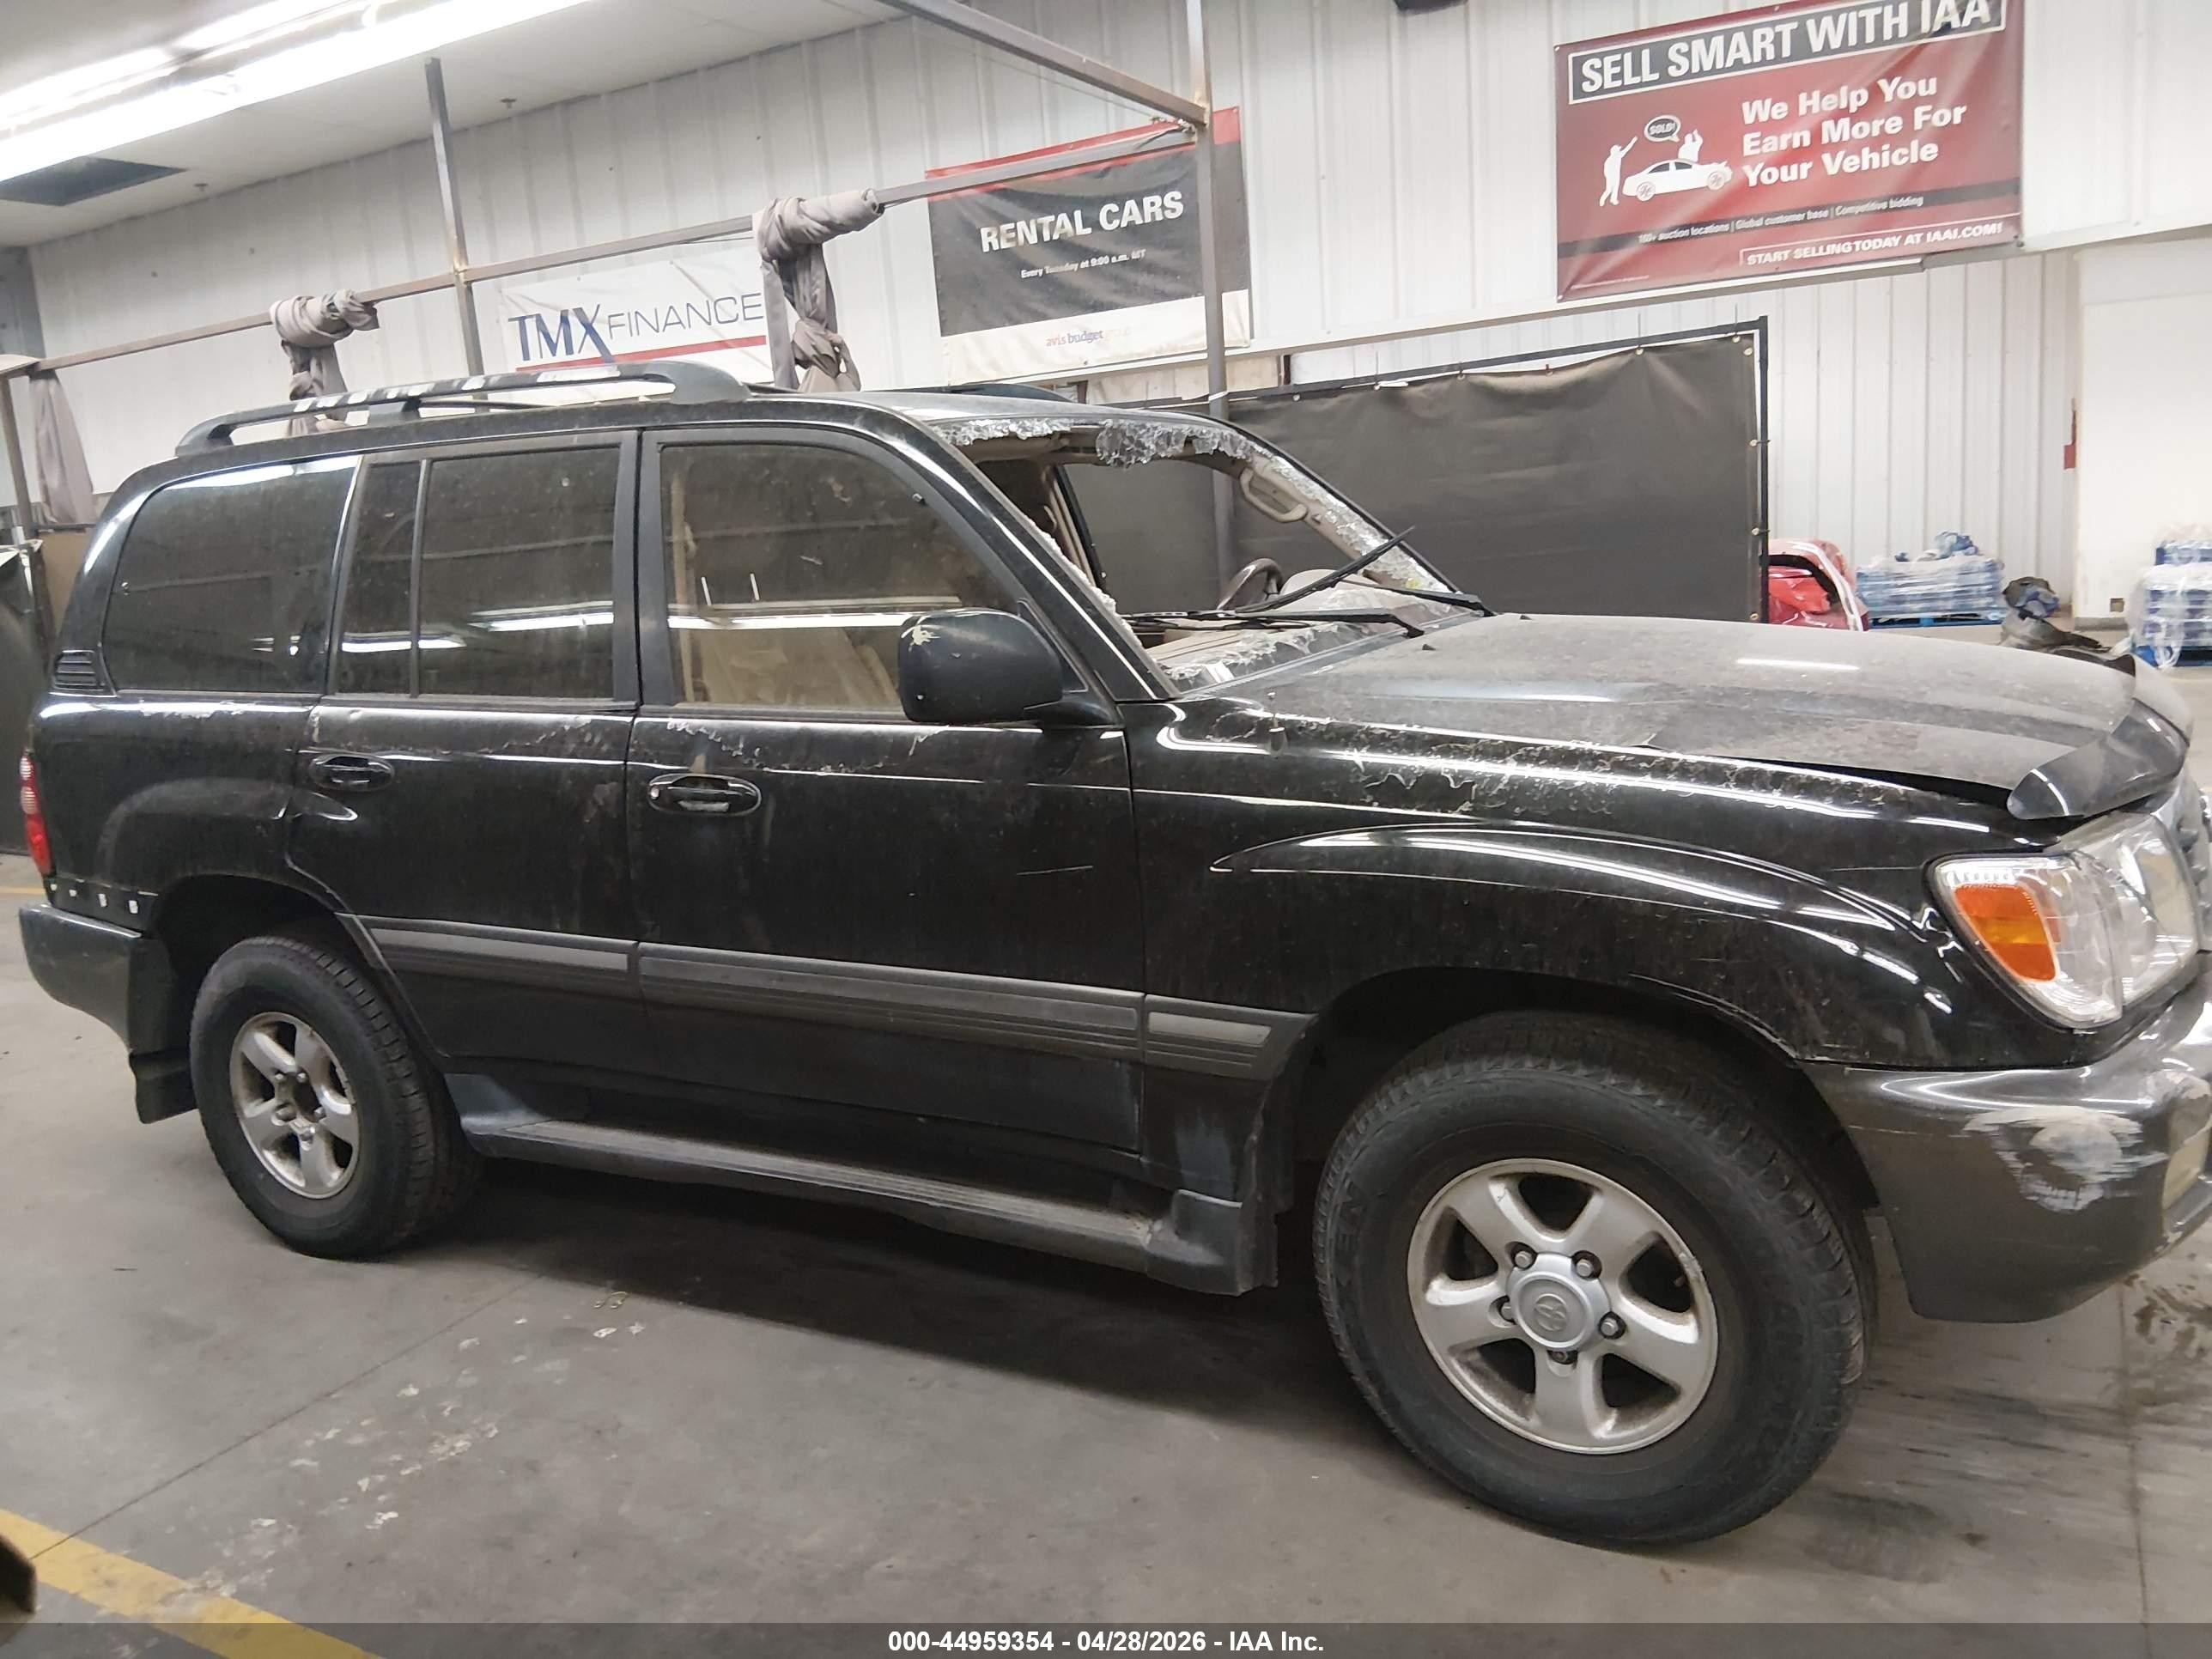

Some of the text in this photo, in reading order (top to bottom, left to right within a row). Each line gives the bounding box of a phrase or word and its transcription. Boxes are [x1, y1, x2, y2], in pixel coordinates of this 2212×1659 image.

[1582, 0, 1991, 93] SELL SMART WITH IAA
[1741, 76, 1937, 125] We Help You
[1743, 104, 1967, 156] Earn More For
[1741, 139, 1939, 187] Your Vehicle
[980, 191, 1184, 252] RENTAL CARS
[1690, 223, 1729, 236] locations
[1747, 222, 2002, 265] START SELLING TODAY AT IAAI.COM!
[1021, 268, 1043, 279] Every
[1080, 260, 1090, 269] at
[508, 293, 764, 363] TMX FINANCE
[1046, 334, 1066, 347] avis
[1067, 331, 1103, 343] budget
